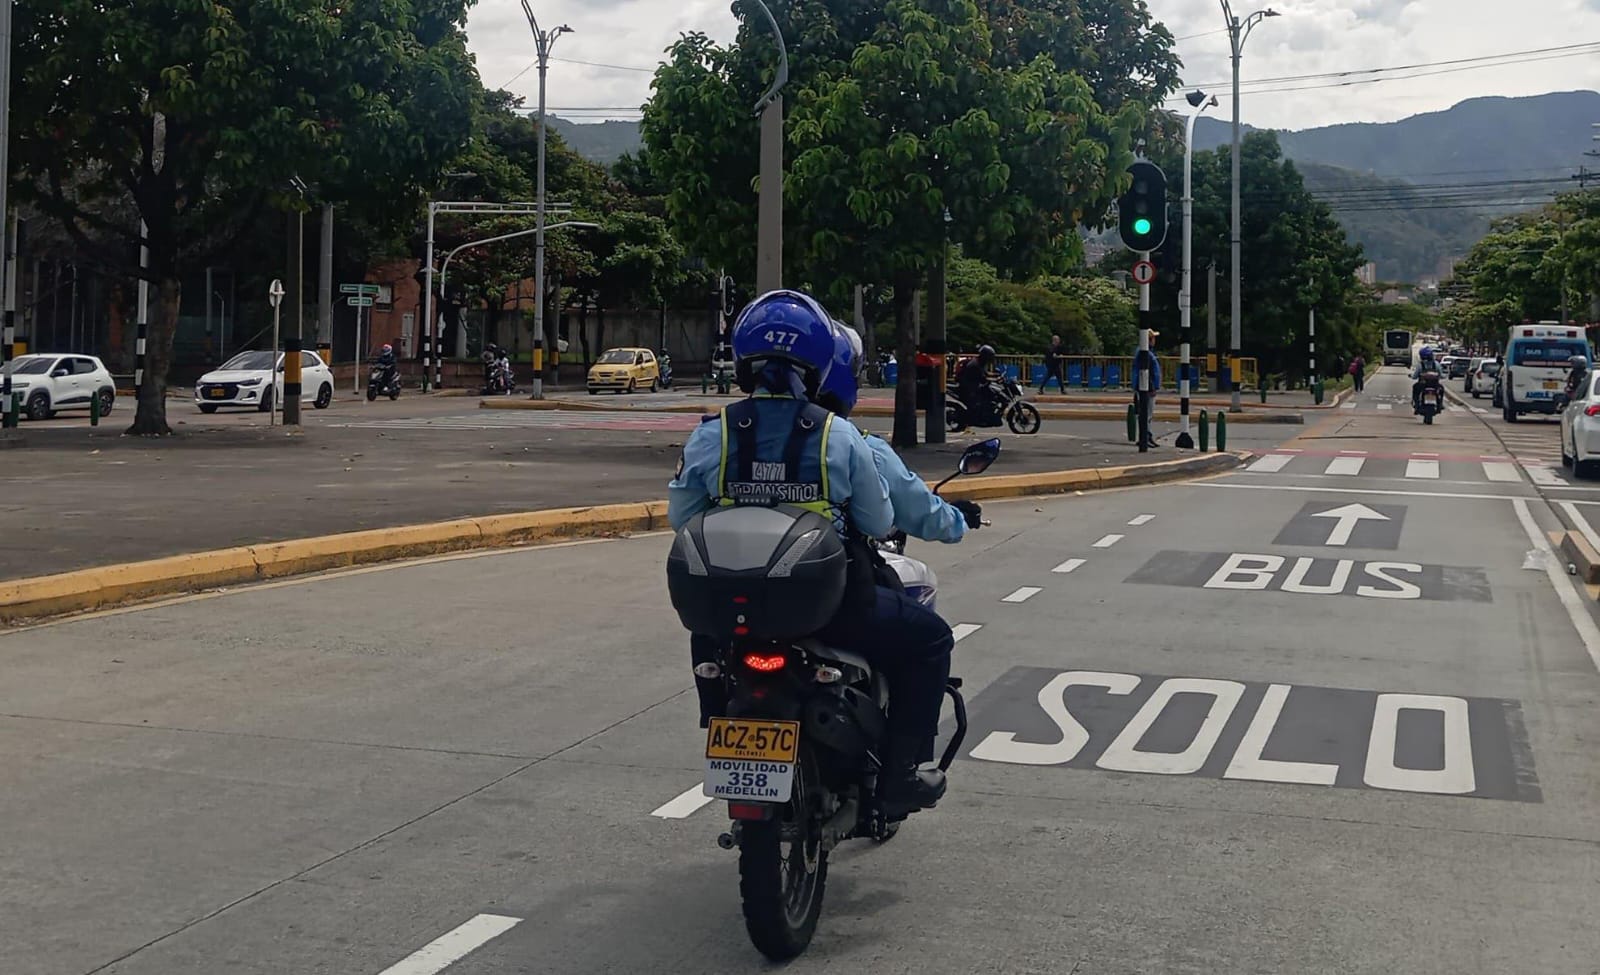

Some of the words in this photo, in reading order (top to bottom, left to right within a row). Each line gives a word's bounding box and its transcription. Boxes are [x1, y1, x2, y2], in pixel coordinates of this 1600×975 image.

[764, 330, 799, 345] 477
[753, 462, 785, 480] 477
[733, 484, 813, 501] TRANSITO
[1203, 553, 1422, 599] BUS
[969, 670, 1475, 794] SOLO
[710, 761, 788, 773] MOVILIDAD
[728, 772, 768, 787] 358
[715, 786, 778, 797] MEDELLIN
